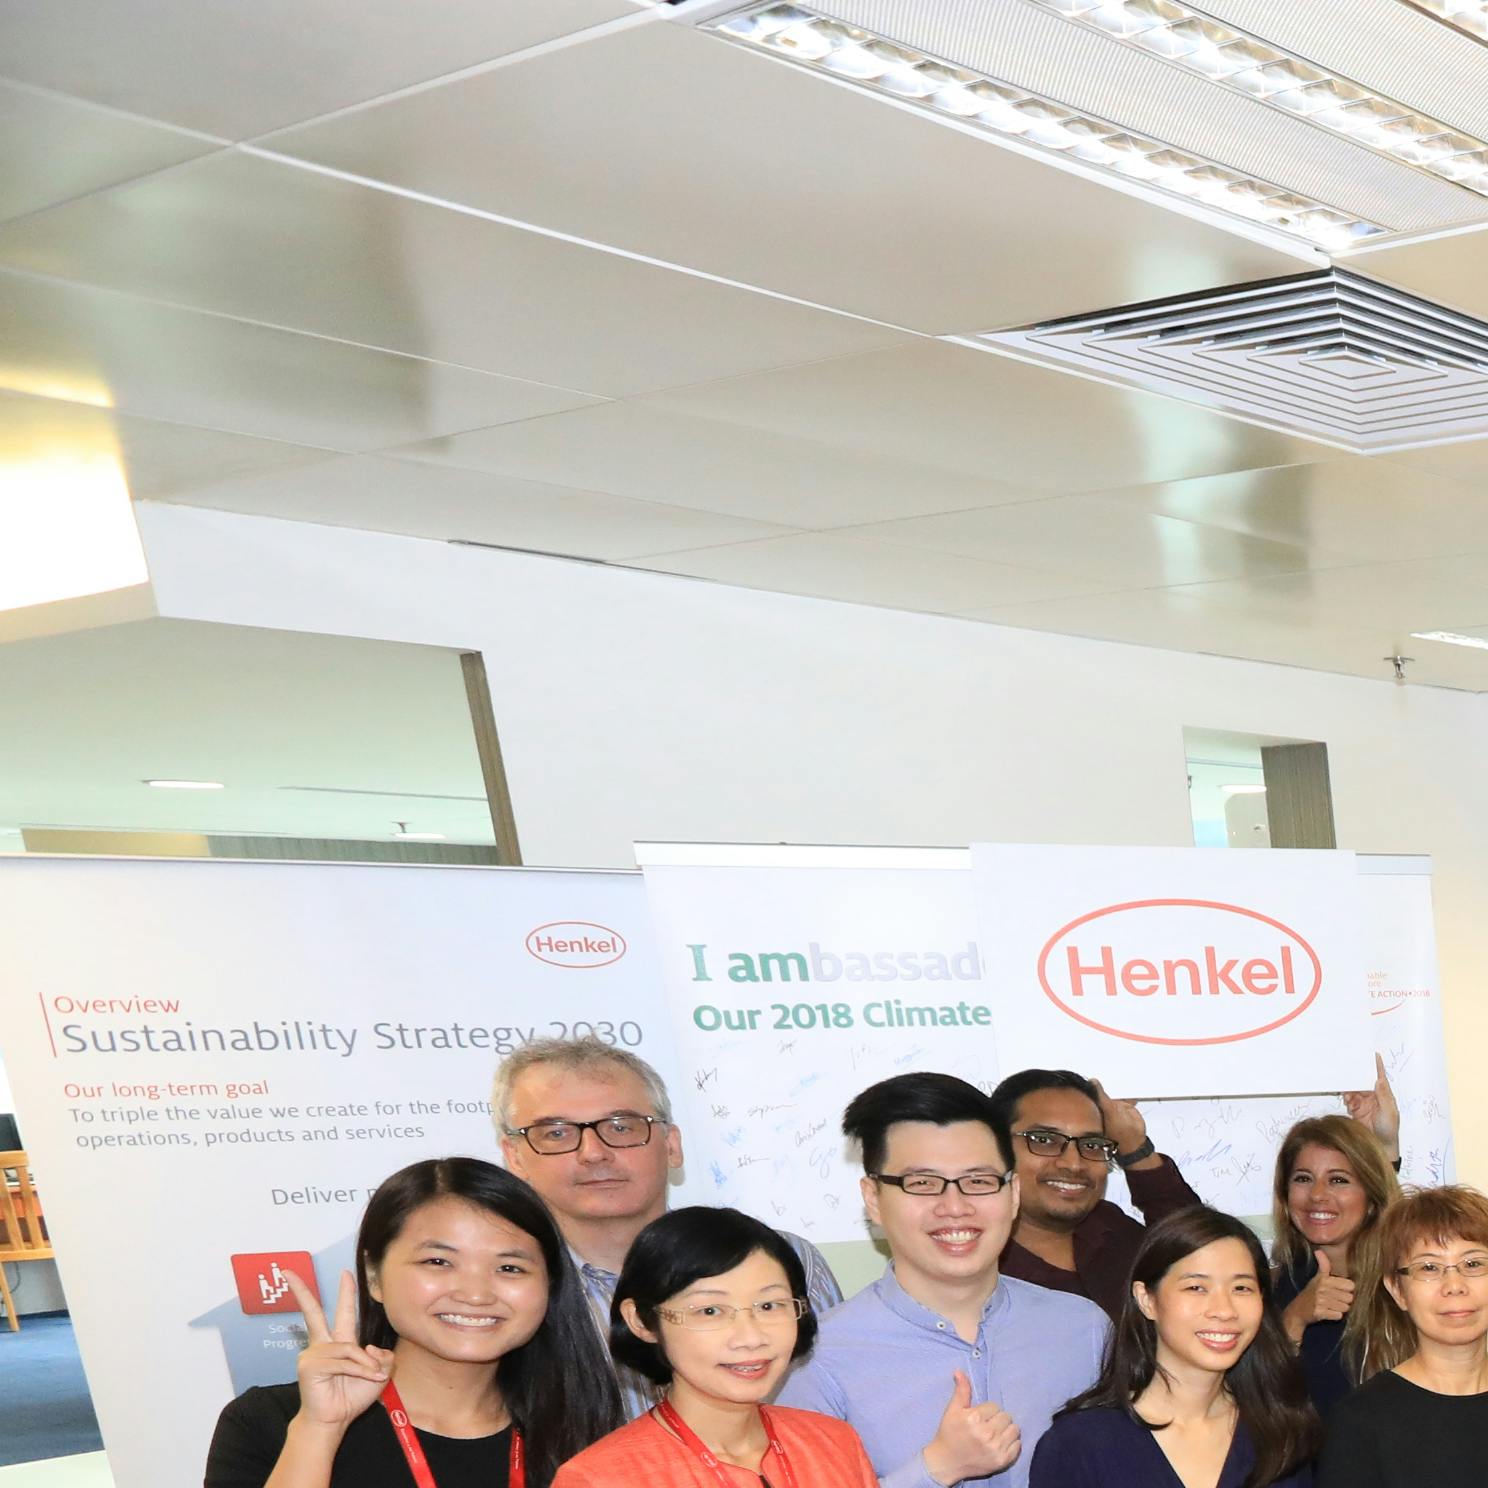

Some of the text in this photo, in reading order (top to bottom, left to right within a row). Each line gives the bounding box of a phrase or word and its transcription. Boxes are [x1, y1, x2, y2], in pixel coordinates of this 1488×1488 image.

[535, 936, 618, 953] Henkel
[686, 942, 987, 983] I ambassad
[1067, 945, 1297, 998] Henkel
[54, 995, 180, 1014] Overview
[693, 999, 992, 1031] Our 2018 Climate
[62, 1020, 357, 1057] Sustainability
[373, 1022, 535, 1055] Strategy
[64, 1080, 269, 1100] Our long-term goal
[68, 1107, 94, 1123] To
[101, 1105, 159, 1125] triple
[166, 1105, 200, 1121] the
[206, 1104, 263, 1120] value
[269, 1106, 299, 1119] we
[305, 1103, 368, 1118] create
[375, 1100, 401, 1117] for
[410, 1100, 441, 1115] the
[77, 1124, 425, 1150] operations, products and services
[271, 1187, 358, 1206] Deliver
